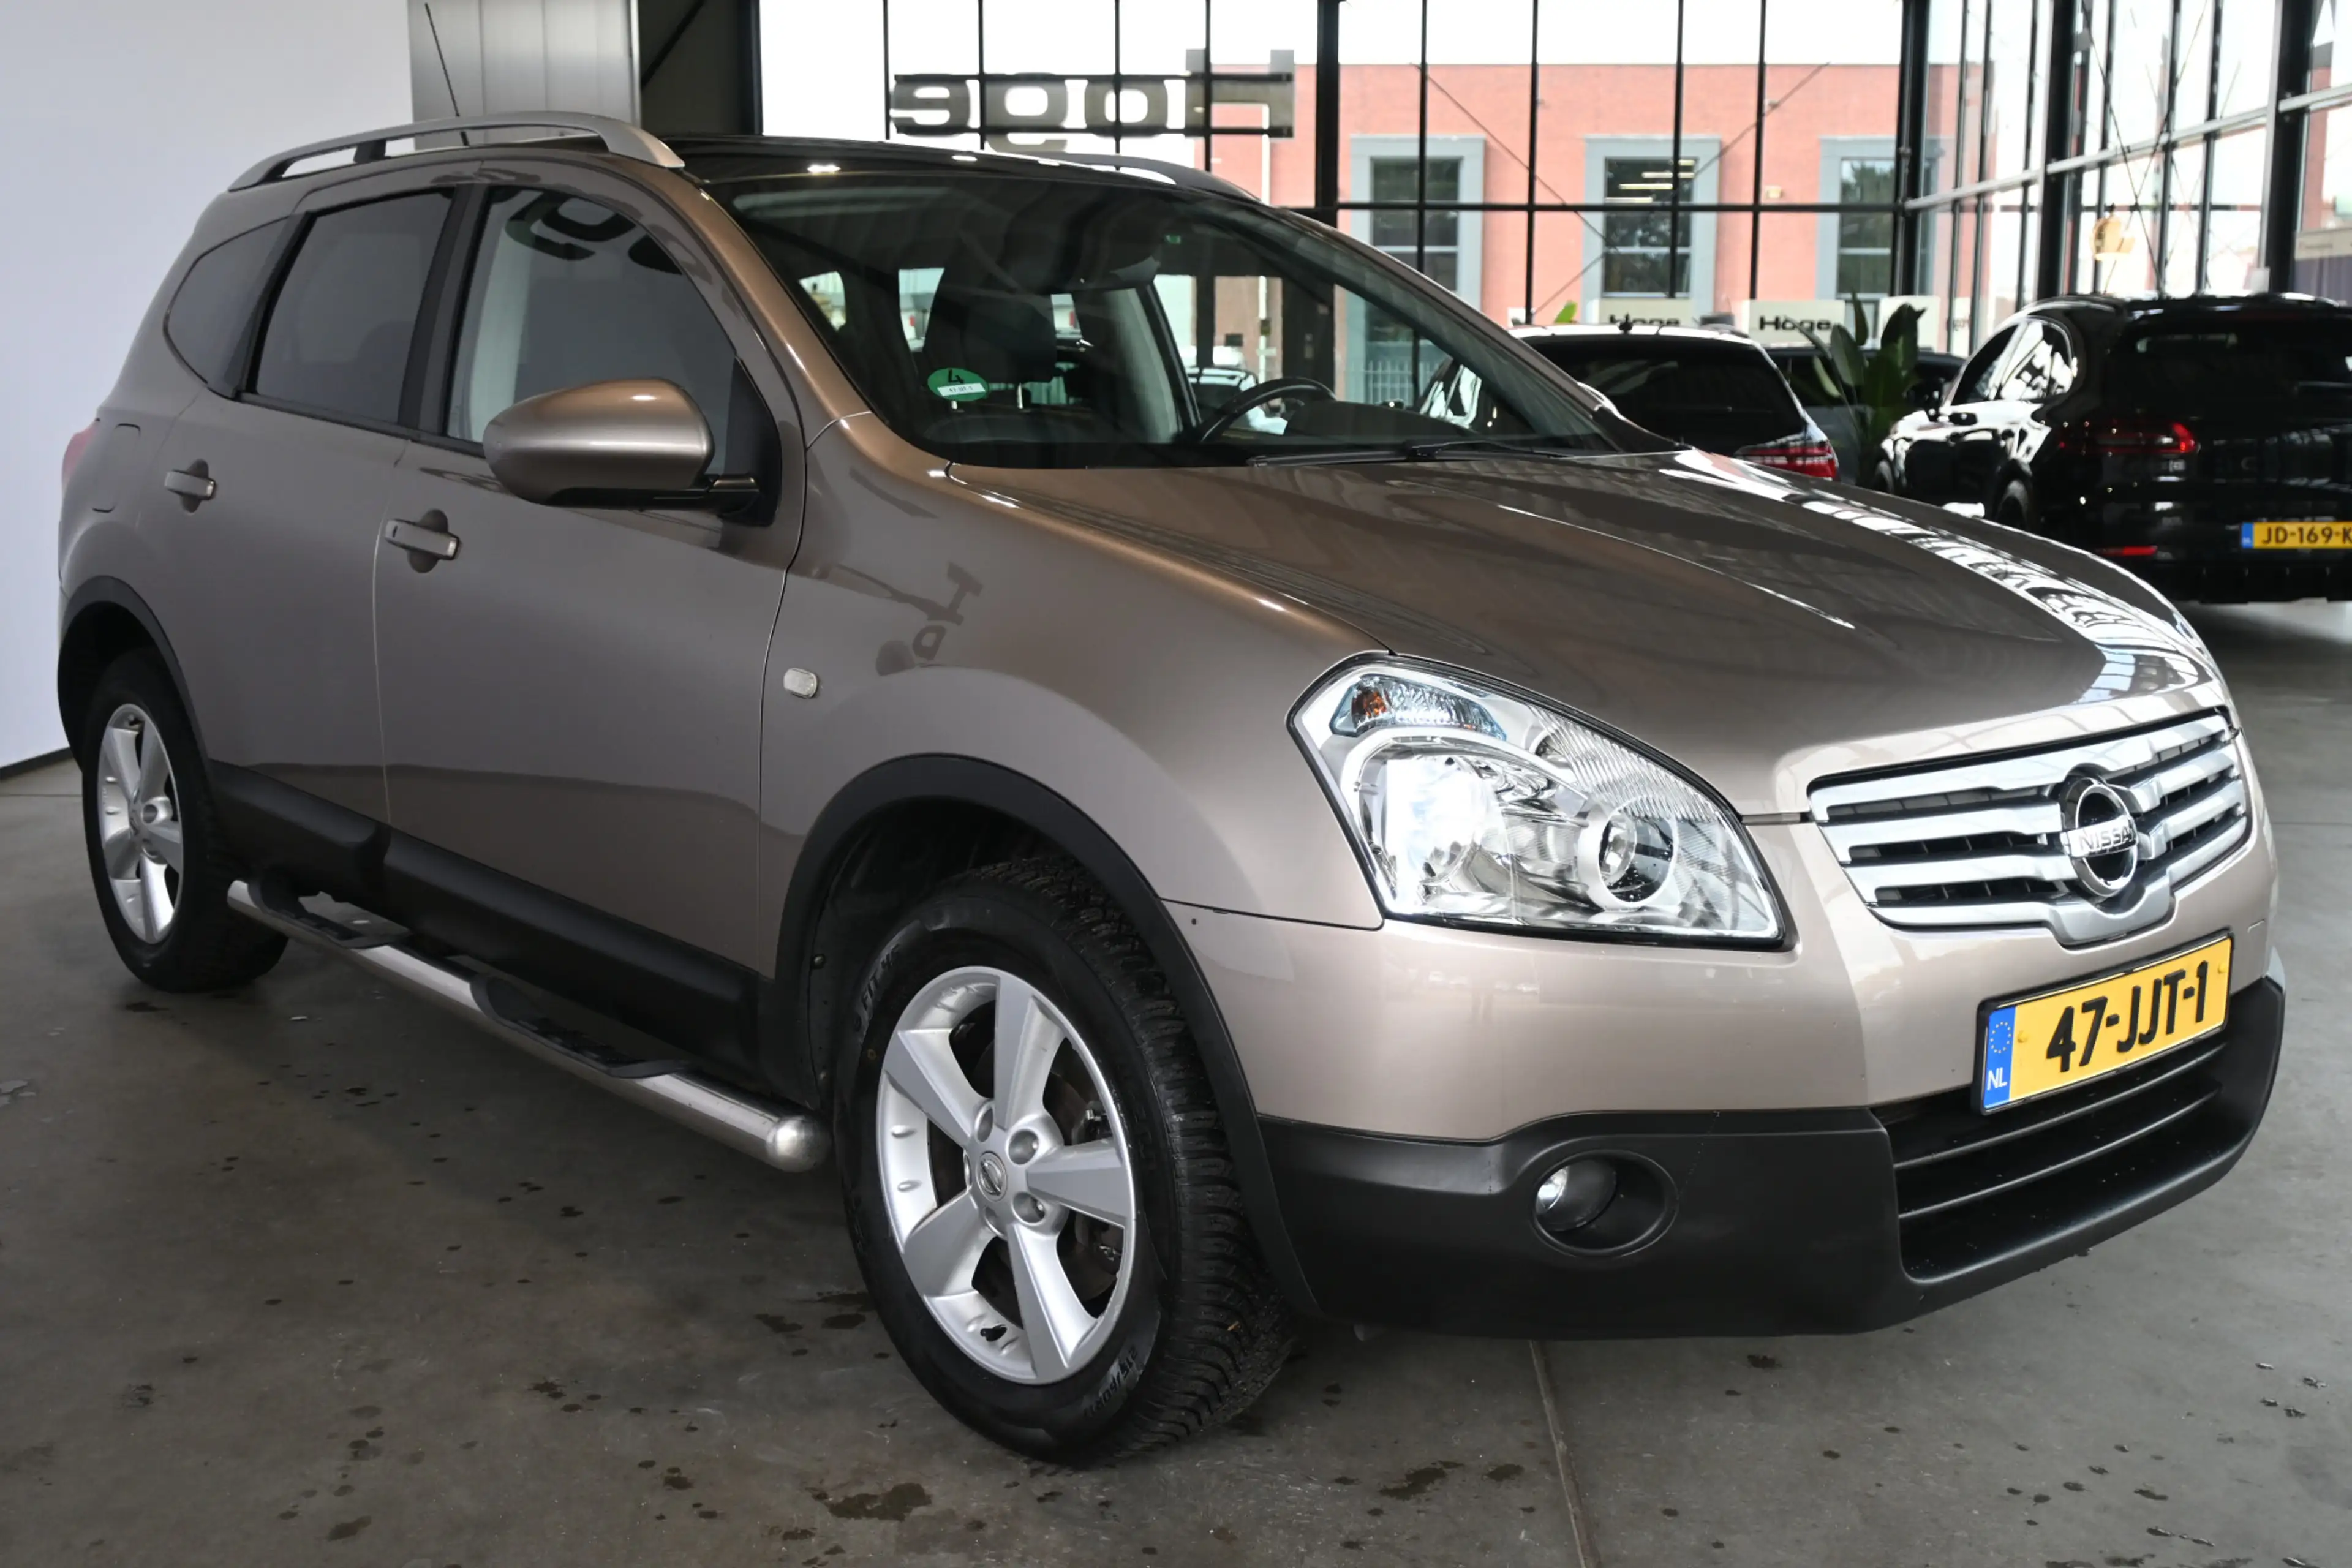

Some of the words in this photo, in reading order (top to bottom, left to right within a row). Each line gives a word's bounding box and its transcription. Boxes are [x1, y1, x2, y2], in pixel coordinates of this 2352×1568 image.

[1759, 315, 1831, 331] Hoge
[2046, 960, 2209, 1072] 47-JJT-1
[1986, 1066, 2007, 1091] NL
